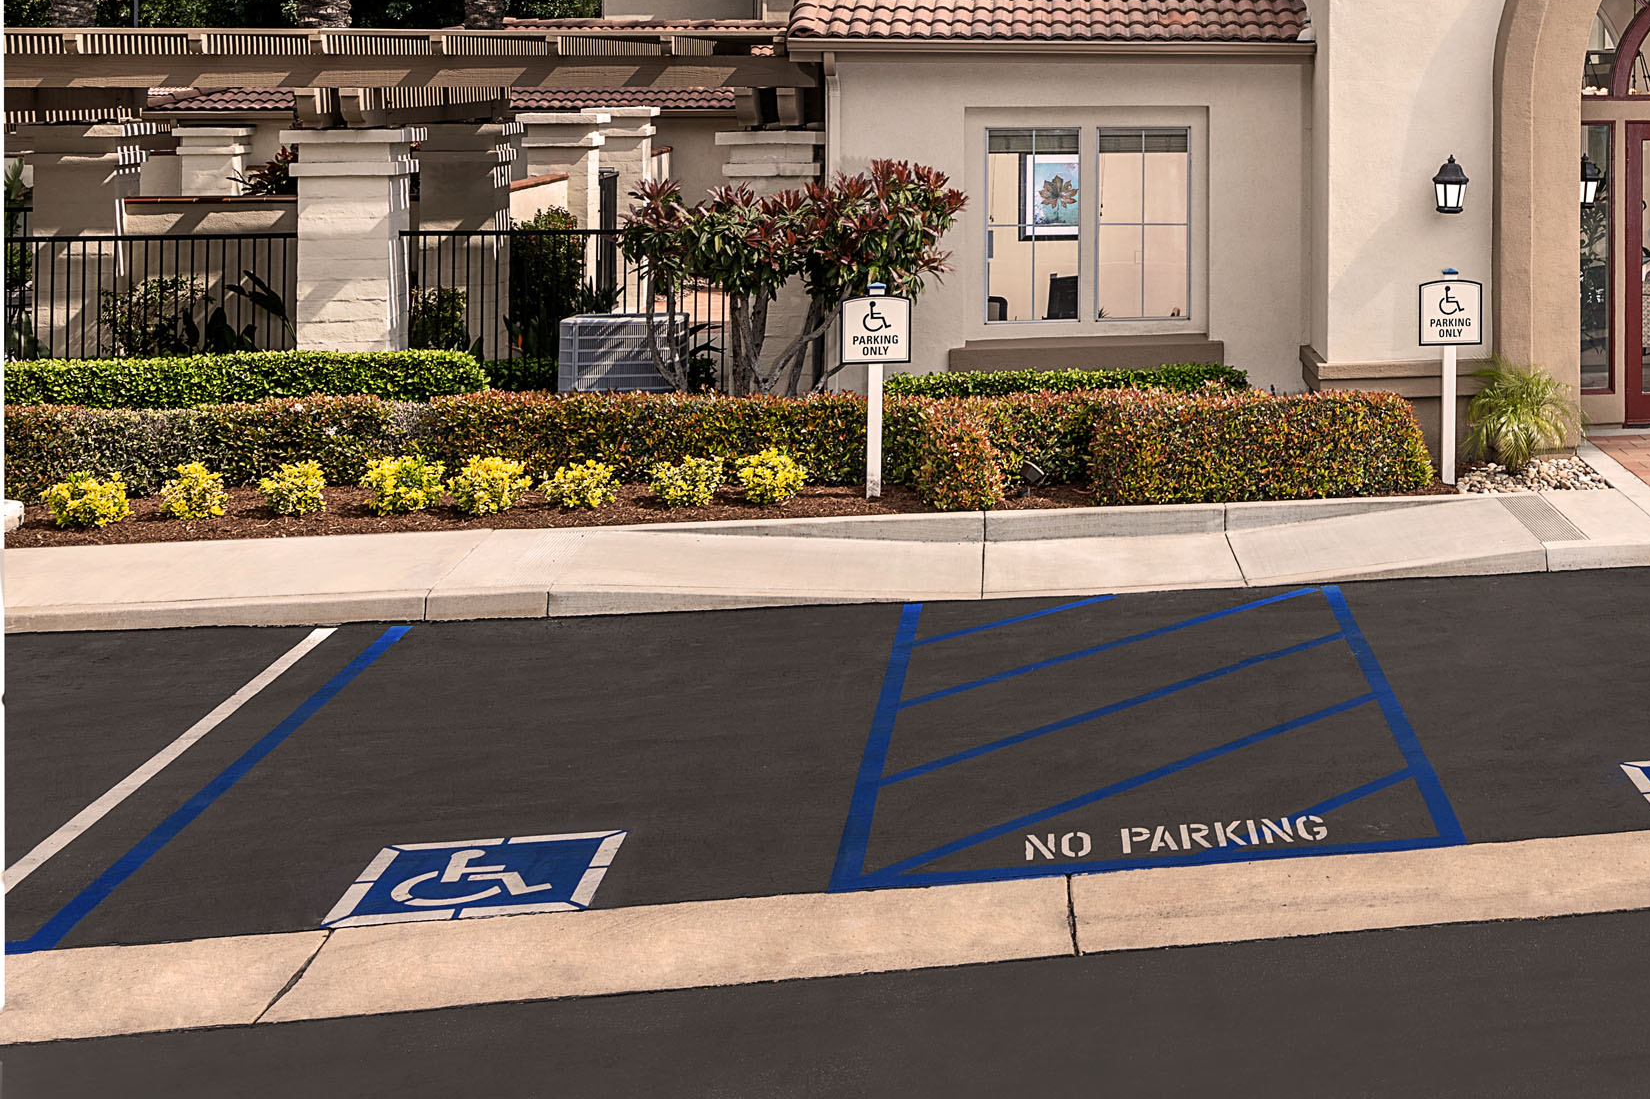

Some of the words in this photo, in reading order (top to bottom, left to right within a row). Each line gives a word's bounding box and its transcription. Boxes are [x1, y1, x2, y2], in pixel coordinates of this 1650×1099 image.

[1430, 318, 1471, 327] PARKING
[1439, 329, 1463, 338] ONLY
[852, 334, 899, 345] PARKING
[862, 346, 889, 356] ONLY
[1025, 831, 1092, 861] NO
[1120, 815, 1328, 854] PARKING
